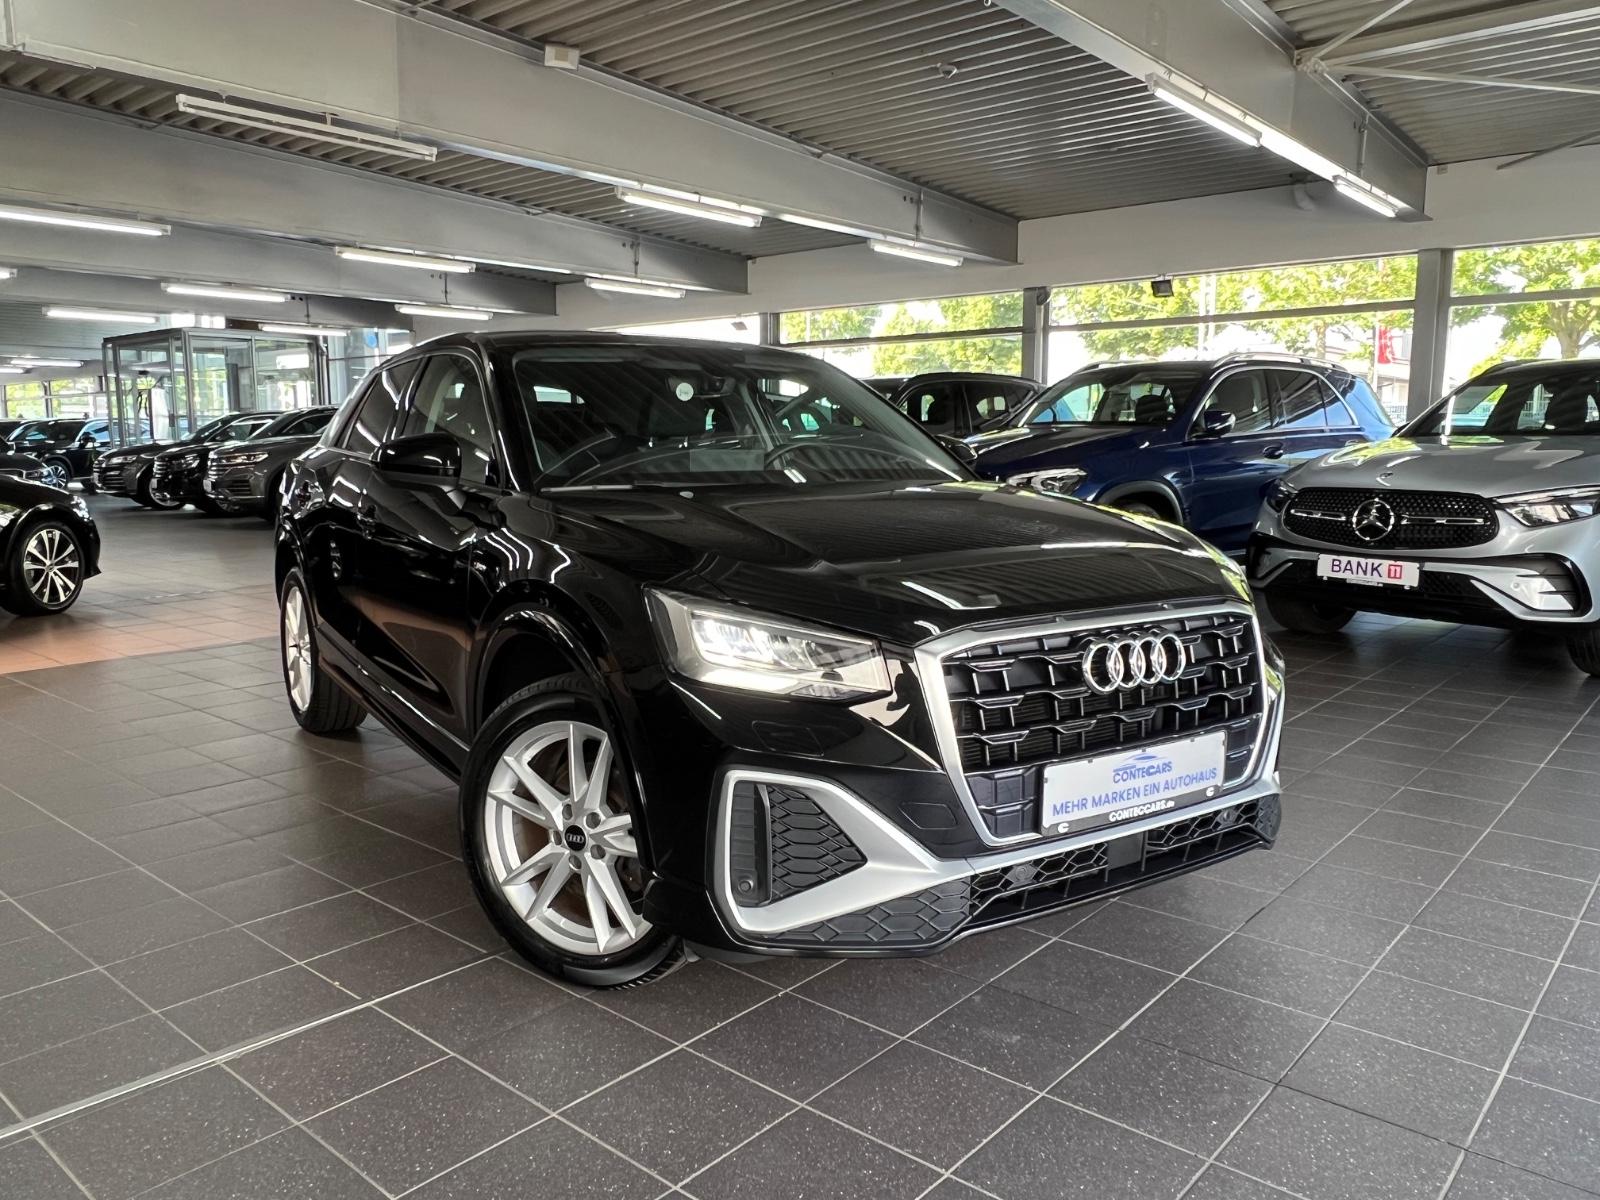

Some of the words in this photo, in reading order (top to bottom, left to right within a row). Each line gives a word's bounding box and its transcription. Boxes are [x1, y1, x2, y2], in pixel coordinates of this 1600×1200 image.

[1331, 558, 1383, 578] BANK
[1052, 798, 1088, 816] MEHR
[1091, 786, 1141, 808] MARKEN
[1143, 781, 1160, 797] EIN
[1163, 767, 1217, 792] AUTOHAUS
